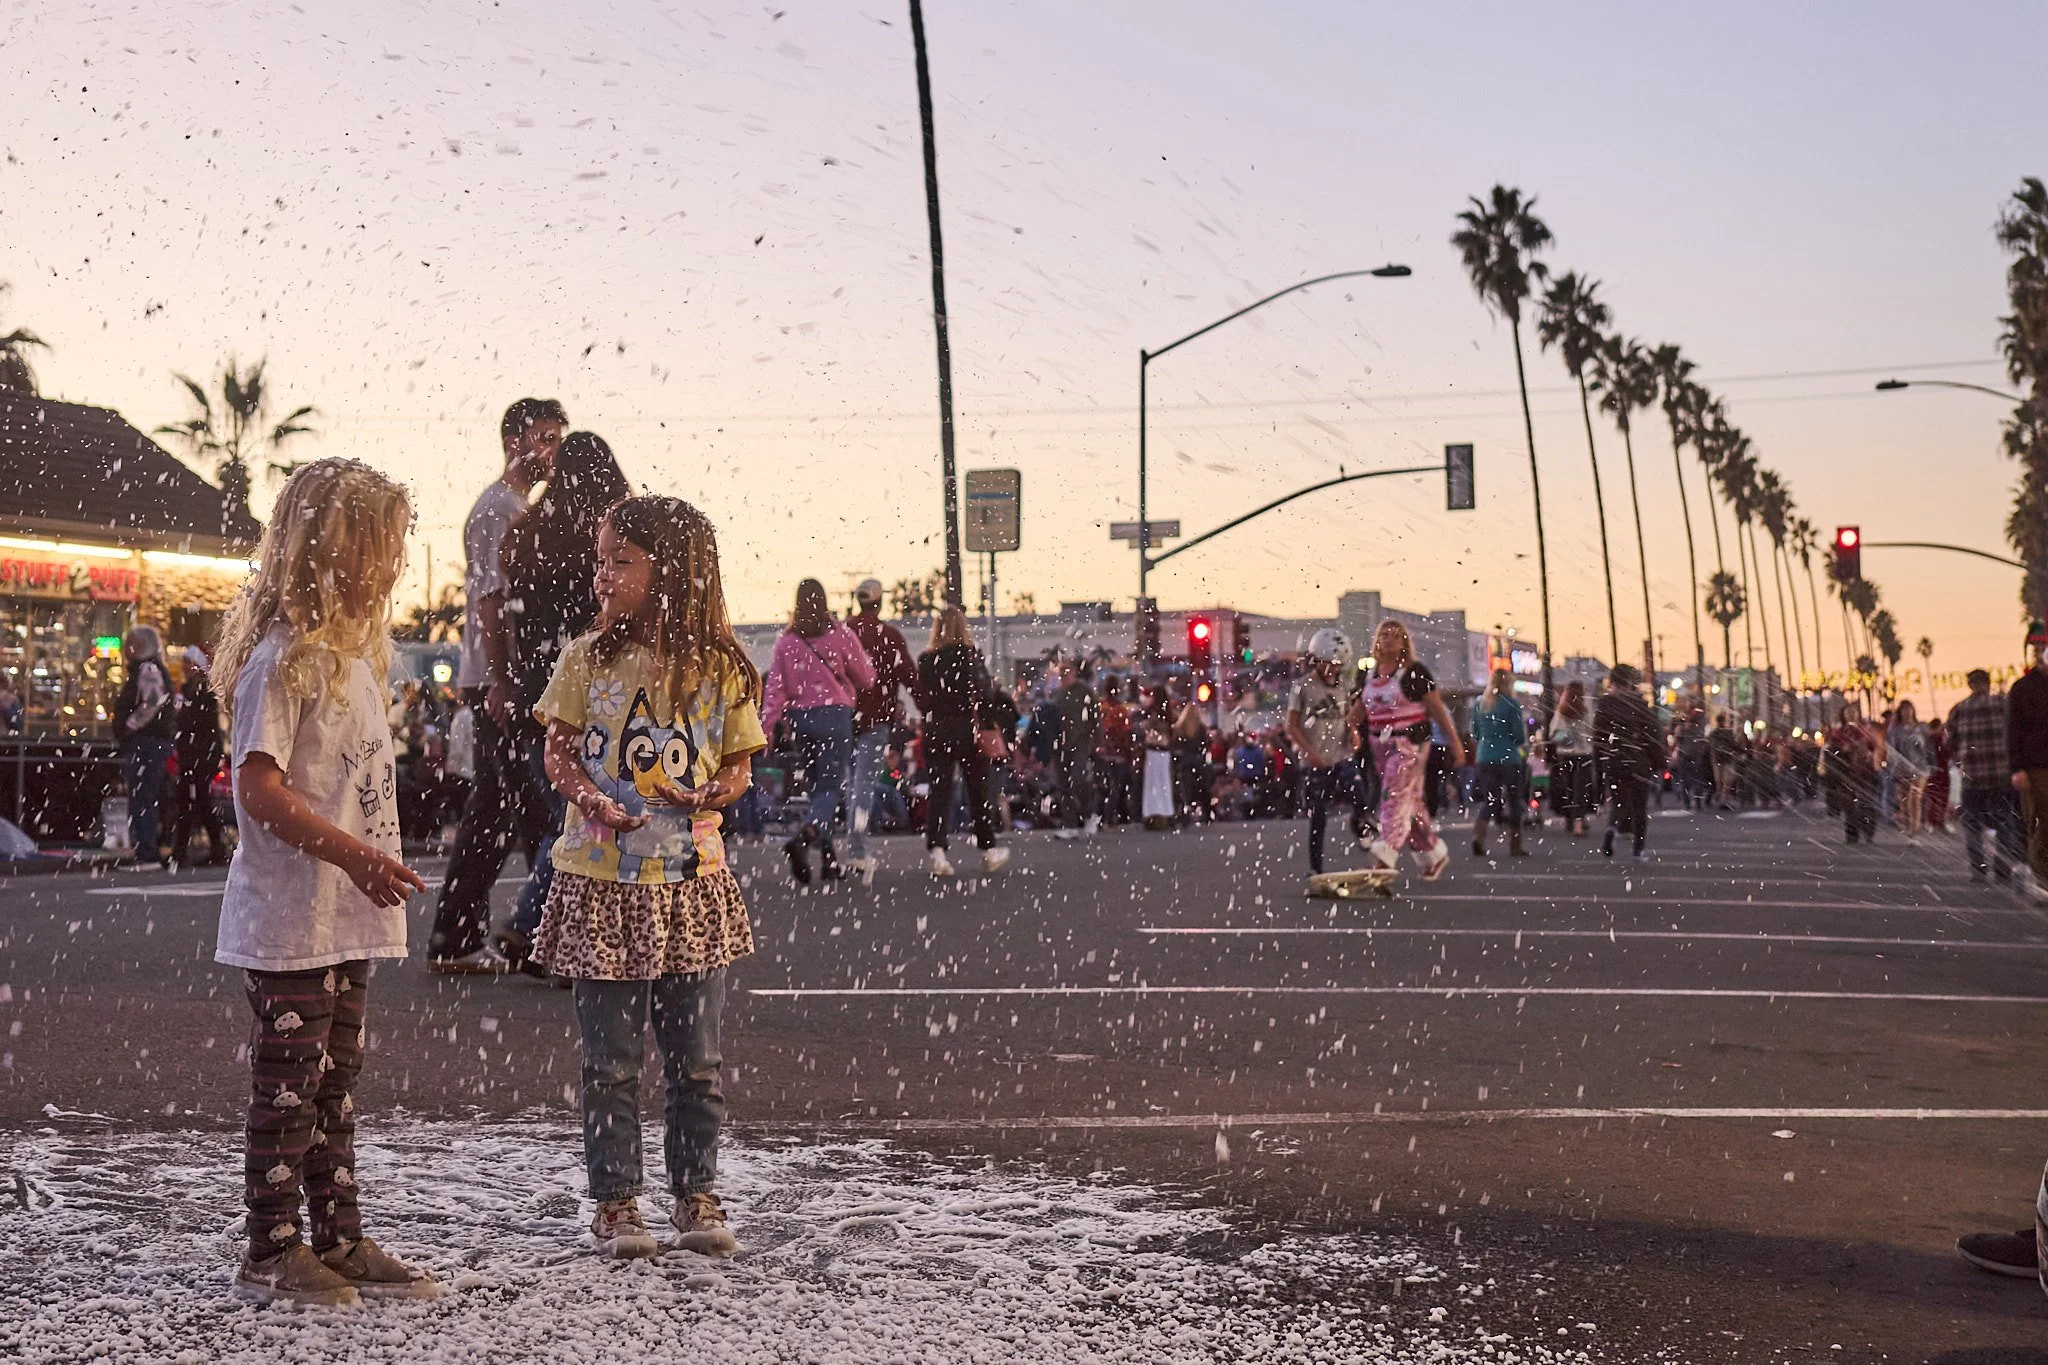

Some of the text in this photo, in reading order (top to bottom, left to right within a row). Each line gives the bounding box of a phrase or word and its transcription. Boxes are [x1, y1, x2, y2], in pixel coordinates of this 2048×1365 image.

[2, 558, 139, 592] STUFF 2 PUFF
